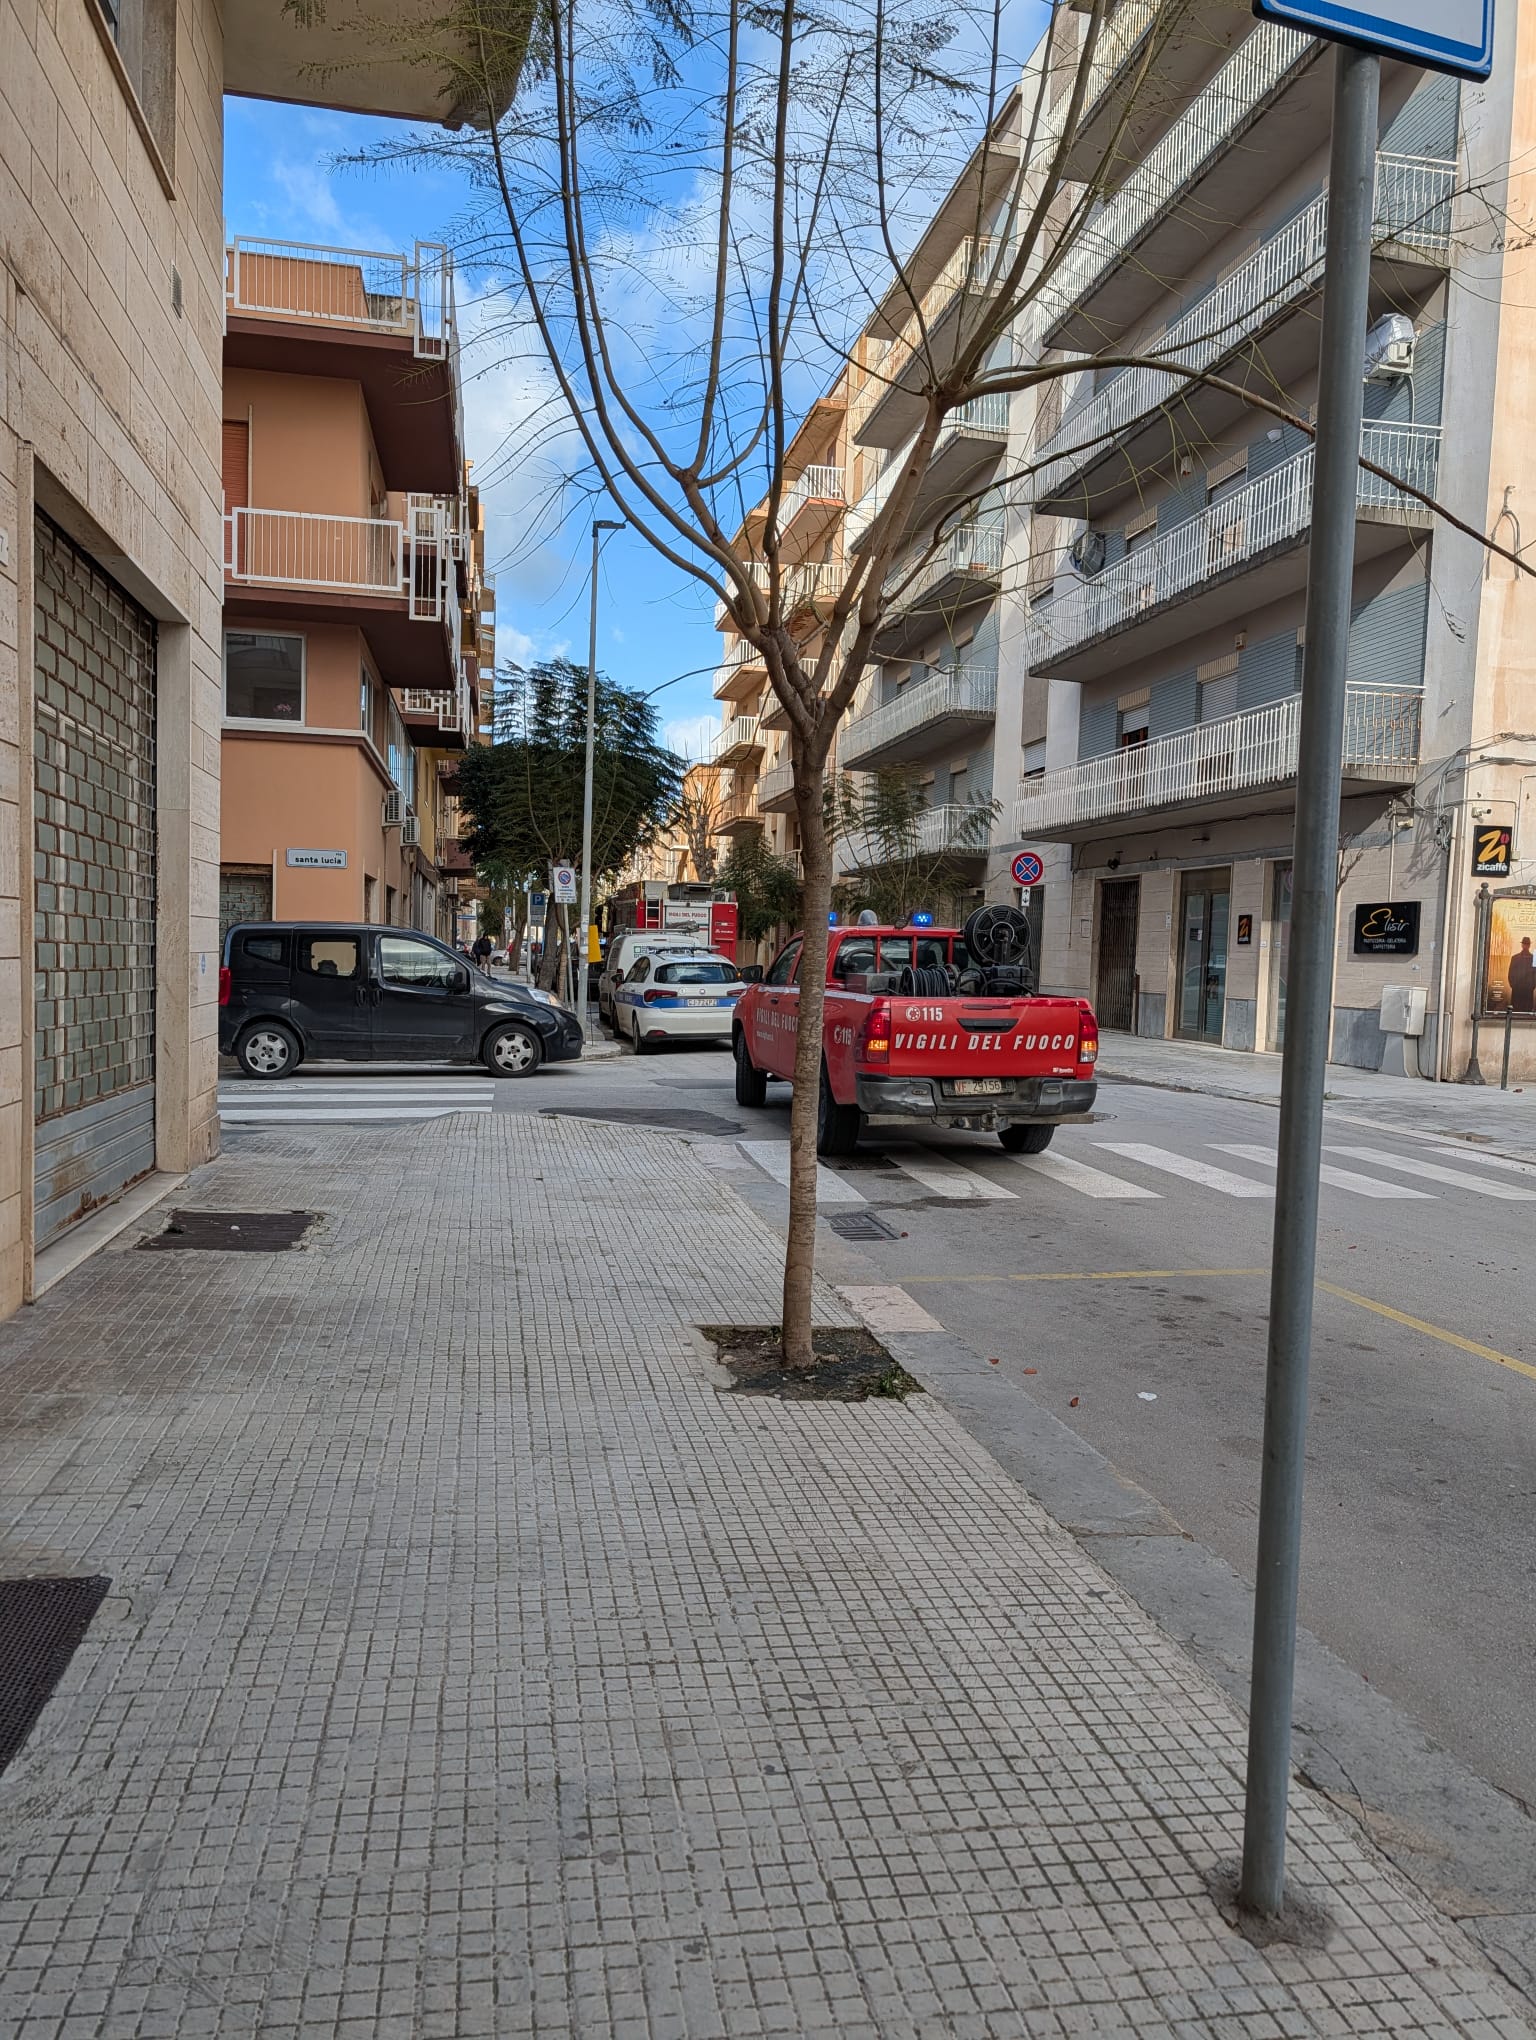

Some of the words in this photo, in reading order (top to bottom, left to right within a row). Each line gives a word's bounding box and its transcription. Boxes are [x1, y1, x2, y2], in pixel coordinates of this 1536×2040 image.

[295, 856, 319, 864] santa
[321, 856, 342, 865] lucia
[1476, 862, 1508, 872] zicaffè
[534, 895, 542, 905] P
[1361, 908, 1410, 937] Elisir
[771, 1011, 780, 1028] DEL
[922, 1007, 943, 1022] 115
[841, 1026, 852, 1046] 115
[895, 1033, 958, 1049] VIGILI
[968, 1034, 1002, 1050] DEL
[1013, 1034, 1075, 1050] FUOCO
[955, 1080, 967, 1093] VF
[973, 1080, 1000, 1093] 29156
